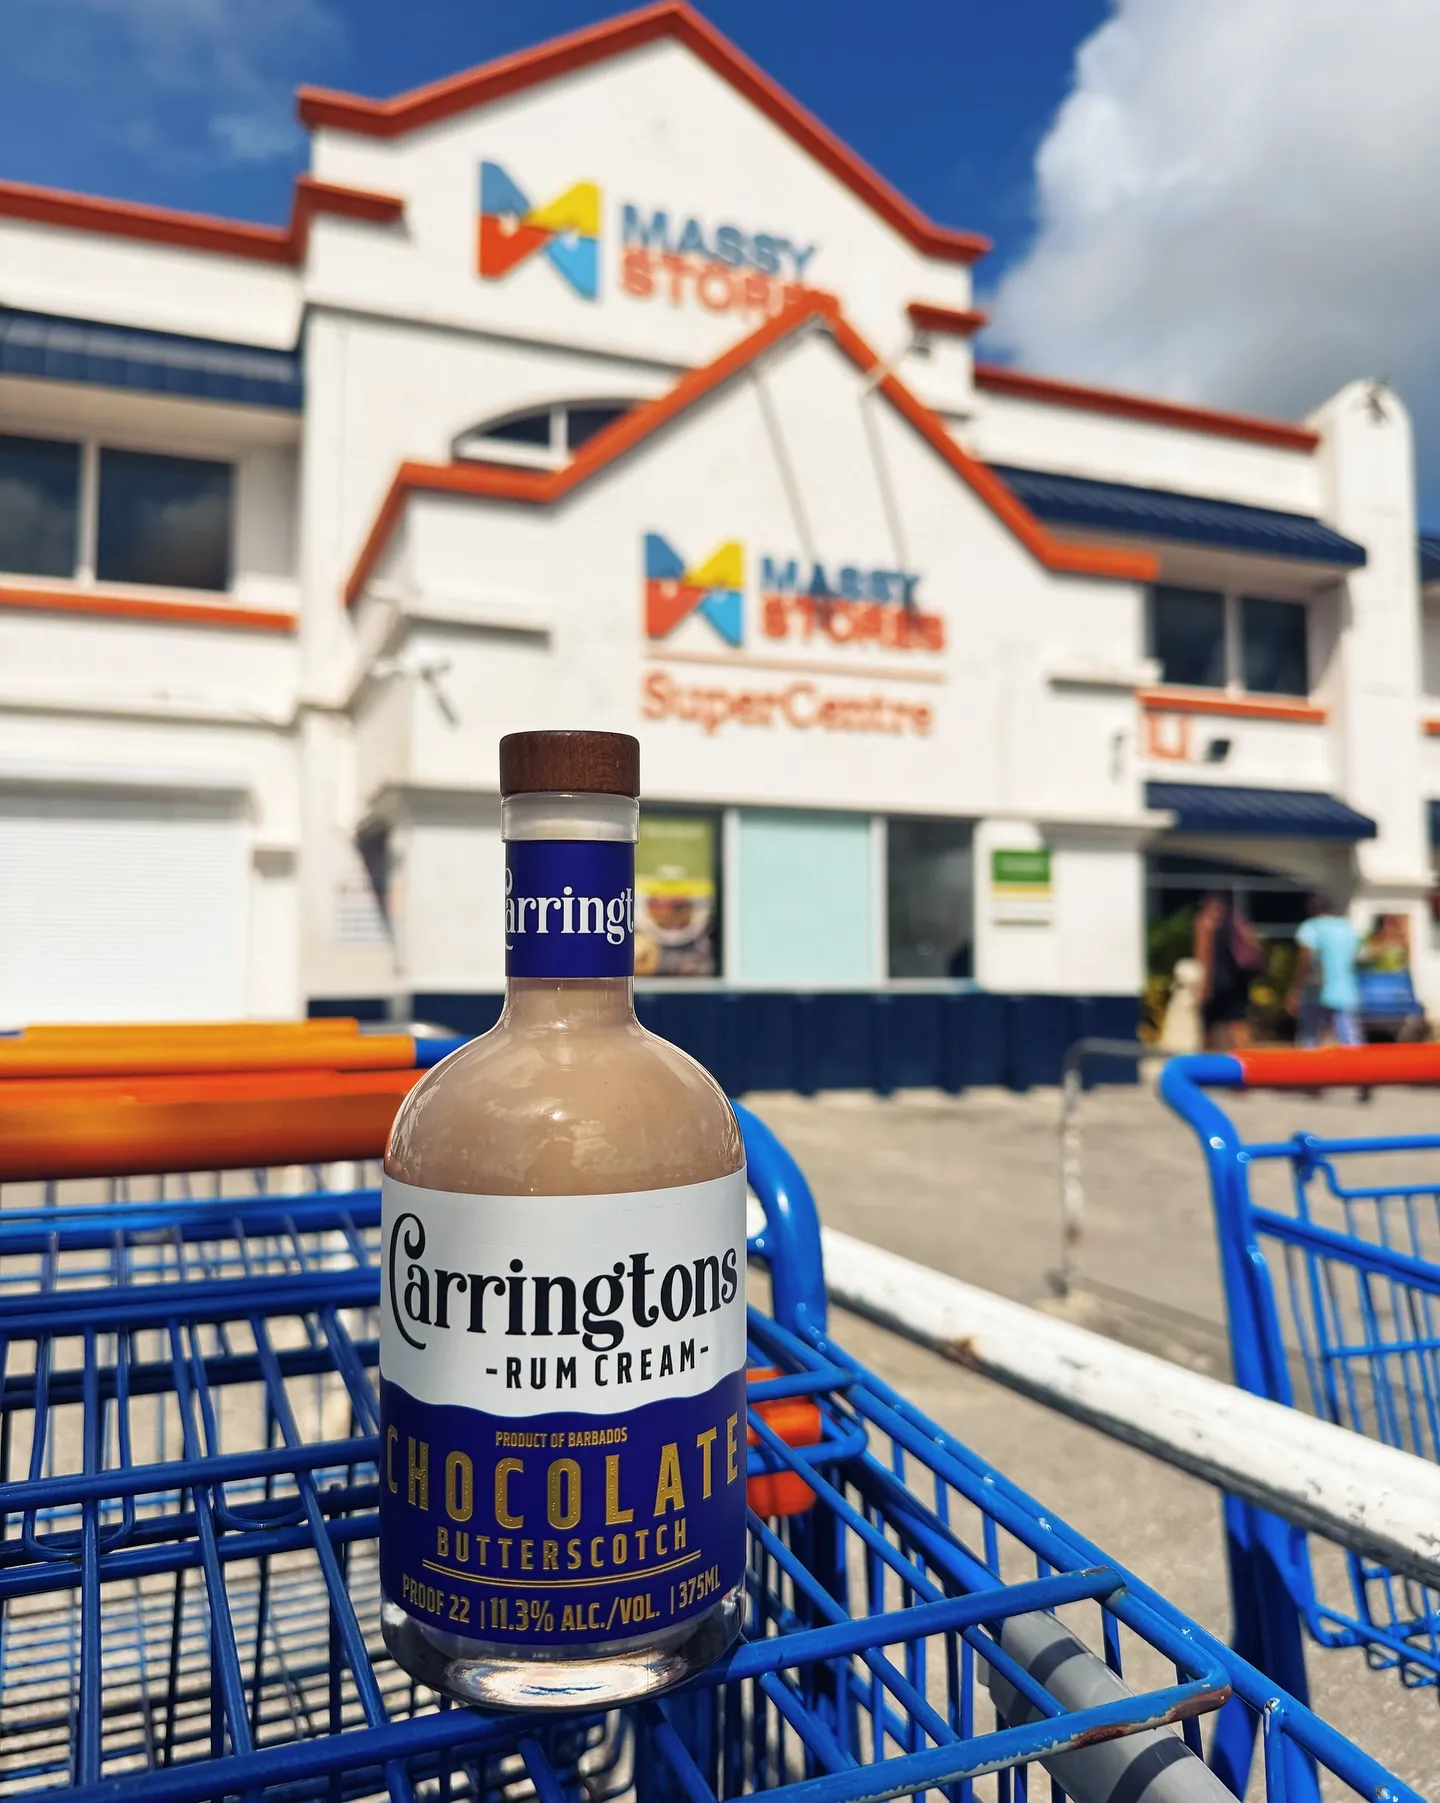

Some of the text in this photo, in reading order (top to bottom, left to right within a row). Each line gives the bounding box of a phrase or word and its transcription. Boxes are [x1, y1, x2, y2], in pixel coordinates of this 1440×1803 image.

[622, 204, 815, 278] MASSY
[620, 248, 804, 322] STOR
[762, 556, 919, 606] MASSY
[761, 594, 944, 651] STORES
[642, 671, 933, 736] SuperCentre
[389, 1212, 738, 1352] Carringtons
[495, 1426, 628, 1448] PRODUCT OF BARBADOS
[386, 1411, 739, 1531] CHOCOLATE
[437, 1517, 687, 1571] BUTTERSCOTCH
[402, 1572, 445, 1616] PROOF
[448, 1595, 470, 1624] 22
[560, 1590, 661, 1632] ALC./VOL.
[679, 1564, 721, 1609] 375ML
